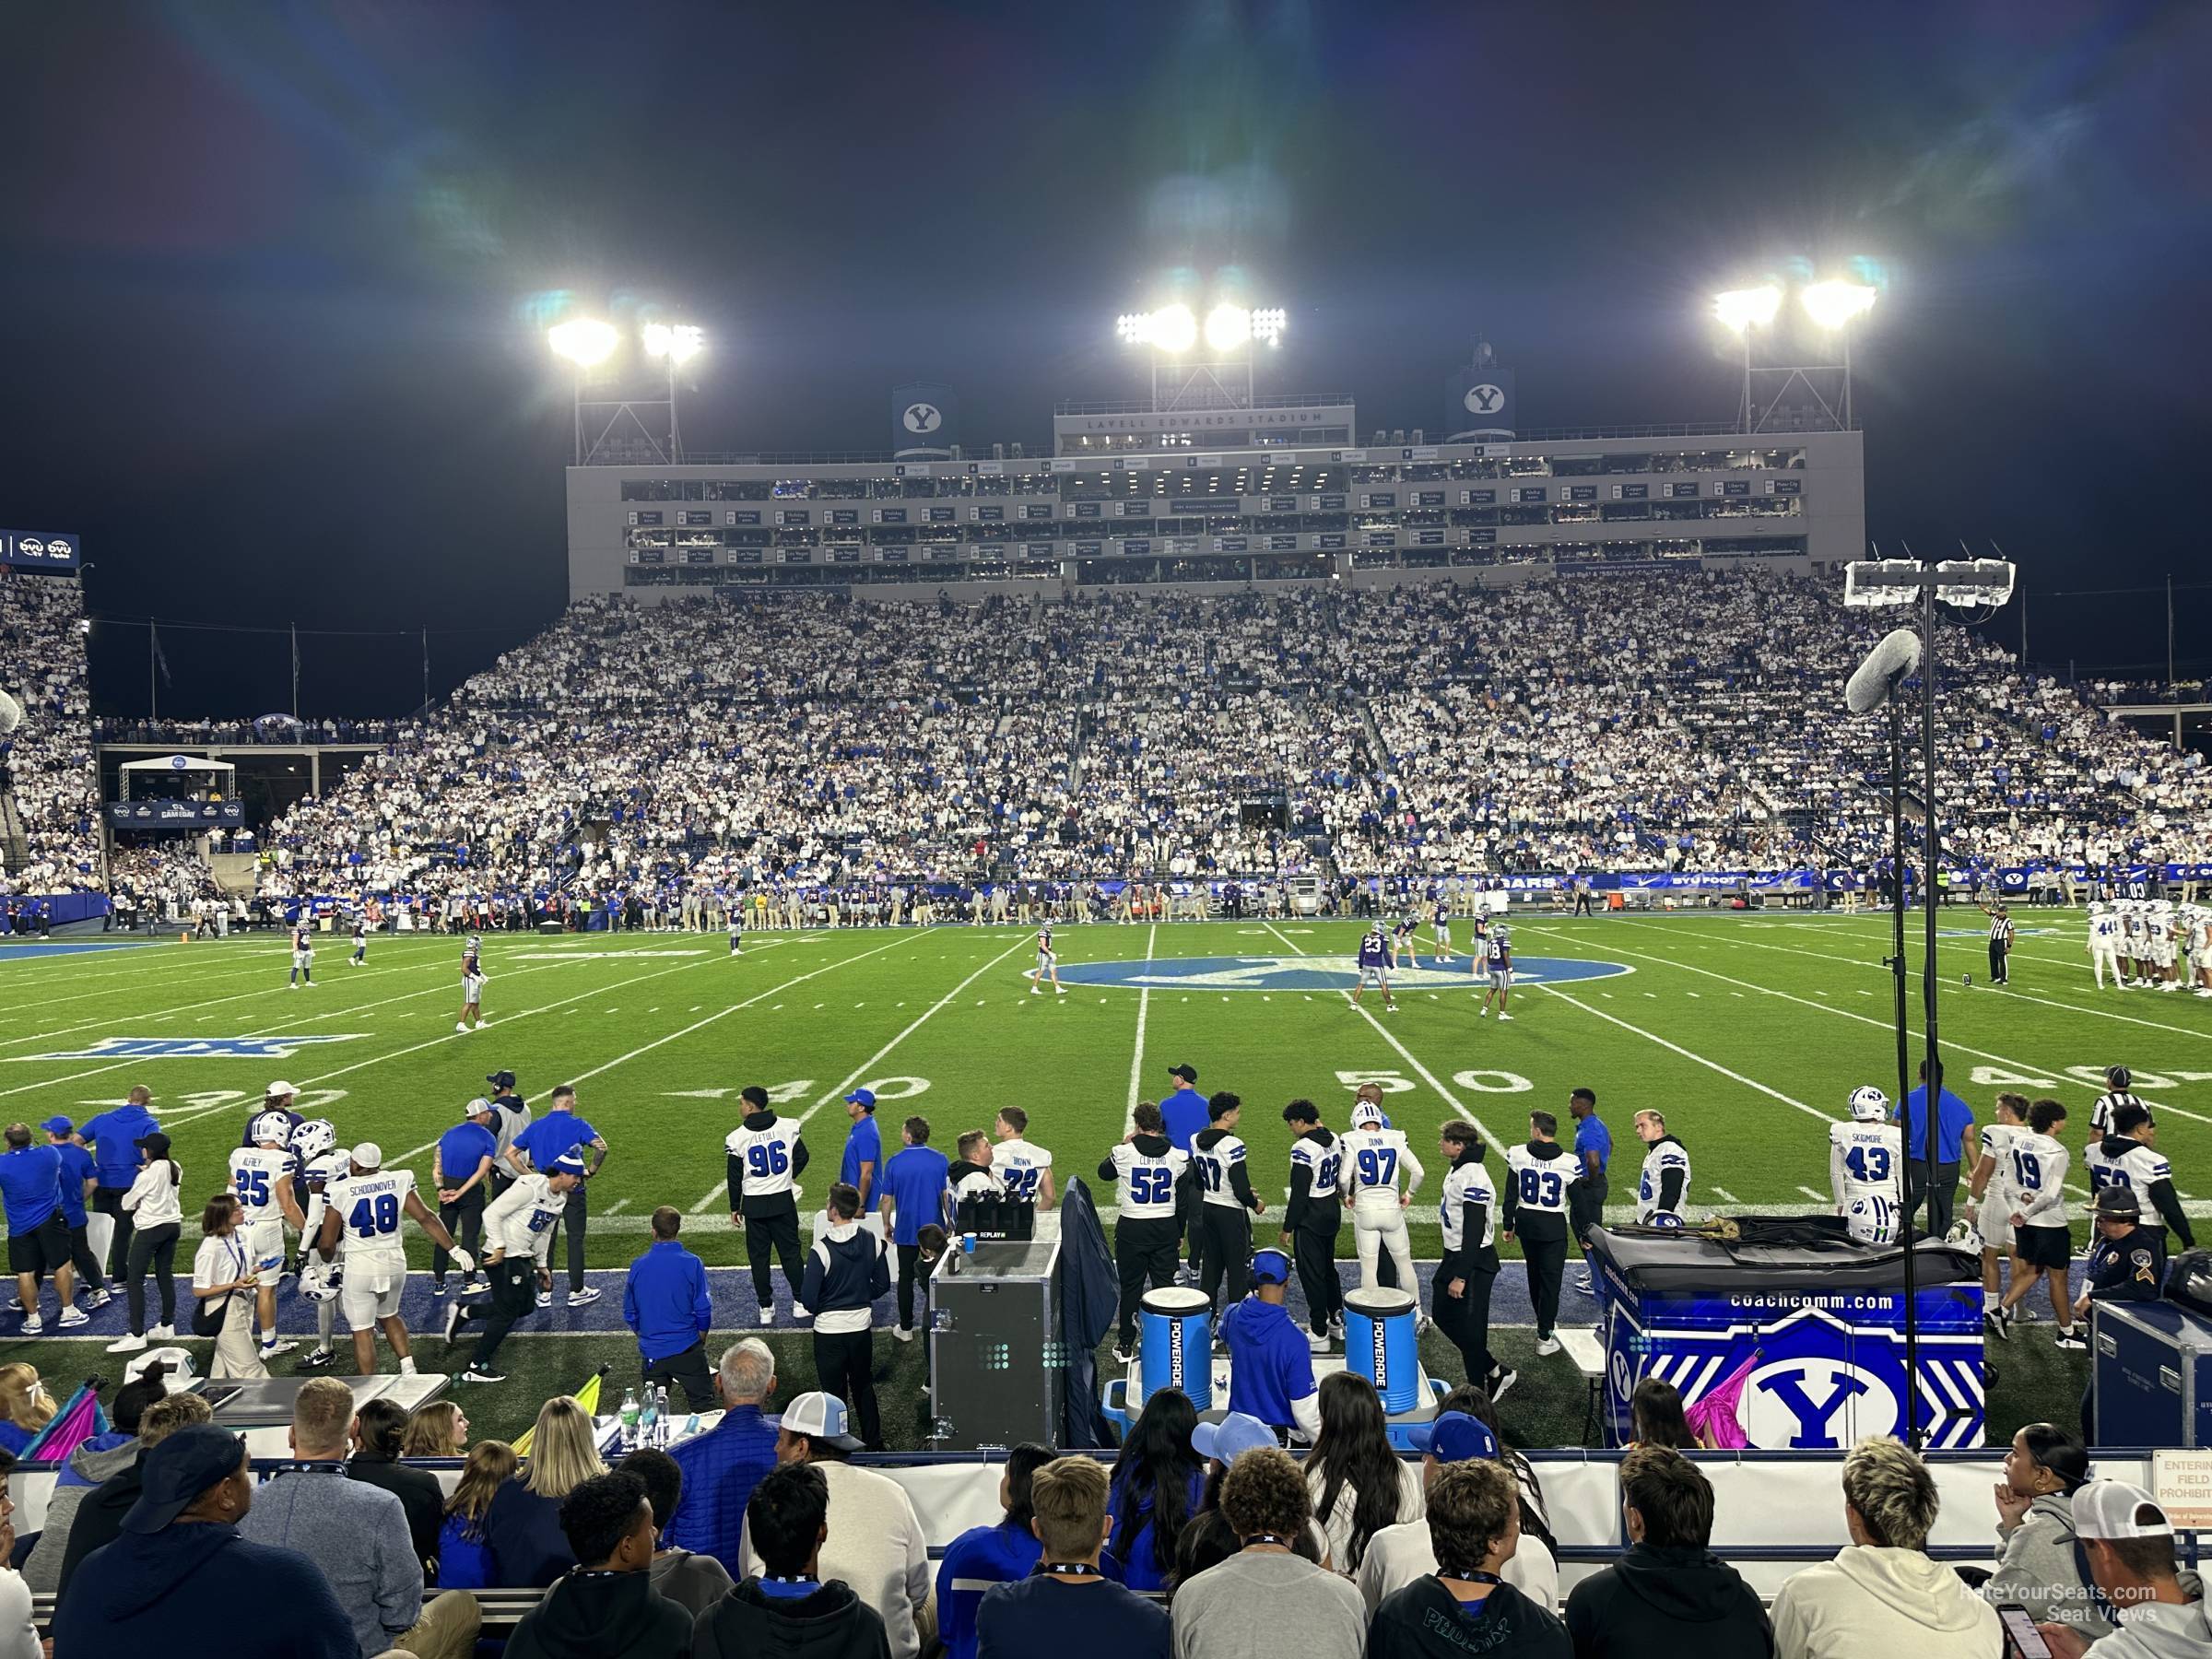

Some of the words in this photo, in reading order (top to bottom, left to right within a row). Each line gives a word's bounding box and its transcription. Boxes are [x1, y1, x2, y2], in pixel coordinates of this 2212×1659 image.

[1088, 419, 1146, 429] LAVELL
[1159, 417, 1235, 427] EDWARDS
[1248, 413, 1322, 424] STADIUM
[1702, 876, 1770, 884] FOOTALL
[2099, 922, 2113, 935] 44
[1365, 937, 1381, 953] 23
[1488, 942, 1501, 959] 18
[1335, 1070, 1534, 1093] 50
[1970, 1066, 2180, 1088] 40
[1368, 1138, 1383, 1147] DUNN
[1852, 1133, 1883, 1144] SKIDMORE
[242, 1157, 263, 1167] ALFREY
[747, 1139, 788, 1177] 96
[1140, 1157, 1166, 1165] CLIFFORD
[1357, 1148, 1397, 1186] 97
[1530, 1157, 1552, 1170] COVEY
[1846, 1146, 1891, 1182] 43
[1316, 1153, 1341, 1188] 82
[2012, 1149, 2041, 1190] 19
[236, 1169, 269, 1207] 25
[1004, 1168, 1038, 1198] 72
[1131, 1167, 1172, 1204] 52
[1520, 1168, 1562, 1208] 83
[349, 1193, 398, 1238] 48
[1605, 1264, 1639, 1307] coachcomm.com
[1730, 1292, 1893, 1309] coachcomm.com
[1171, 1322, 1183, 1387] POWERADE
[1374, 1322, 1386, 1387] POWERADE
[2165, 1461, 2212, 1470] ENTERIN
[2177, 1475, 2210, 1484] FIELD
[2160, 1488, 2212, 1498] PROHIBIT
